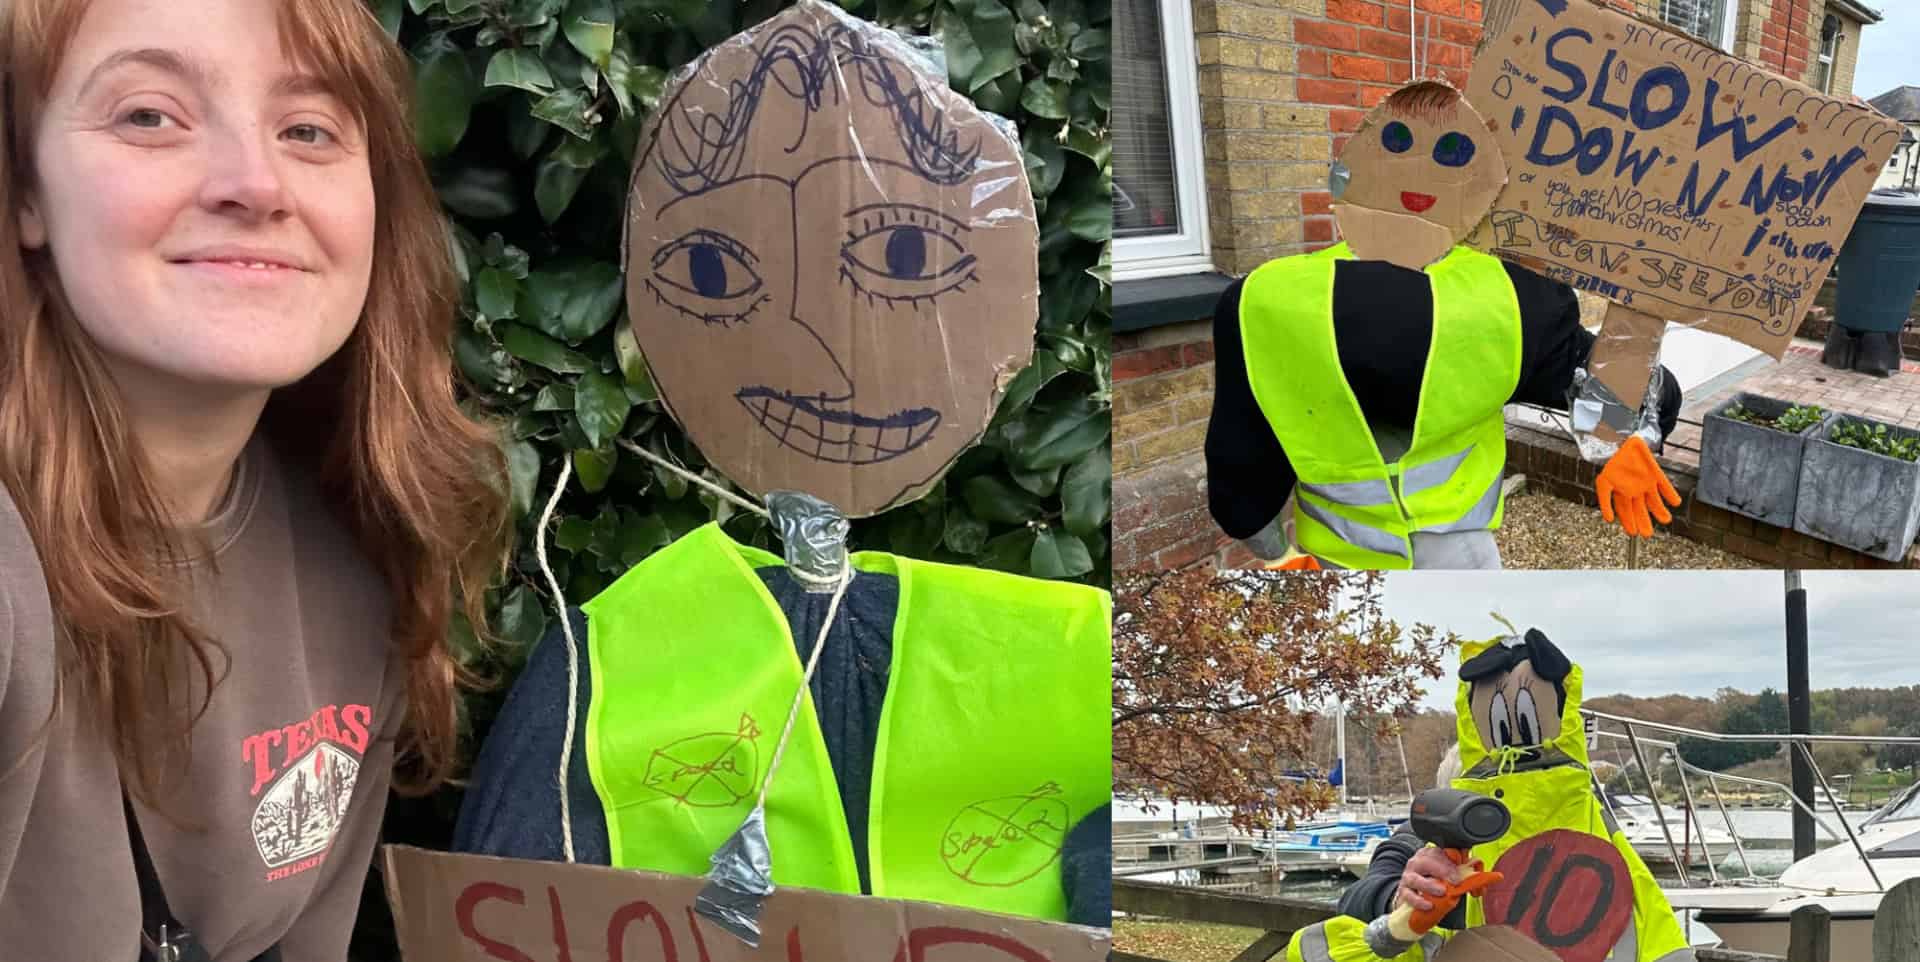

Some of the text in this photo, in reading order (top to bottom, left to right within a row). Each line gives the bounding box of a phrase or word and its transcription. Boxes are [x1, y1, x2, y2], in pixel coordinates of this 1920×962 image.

[1541, 27, 1798, 162] SLOW
[1606, 184, 1643, 212] NO
[1638, 257, 1711, 298] SEE
[242, 703, 372, 795] TEXAS
[1505, 842, 1616, 948] 10
